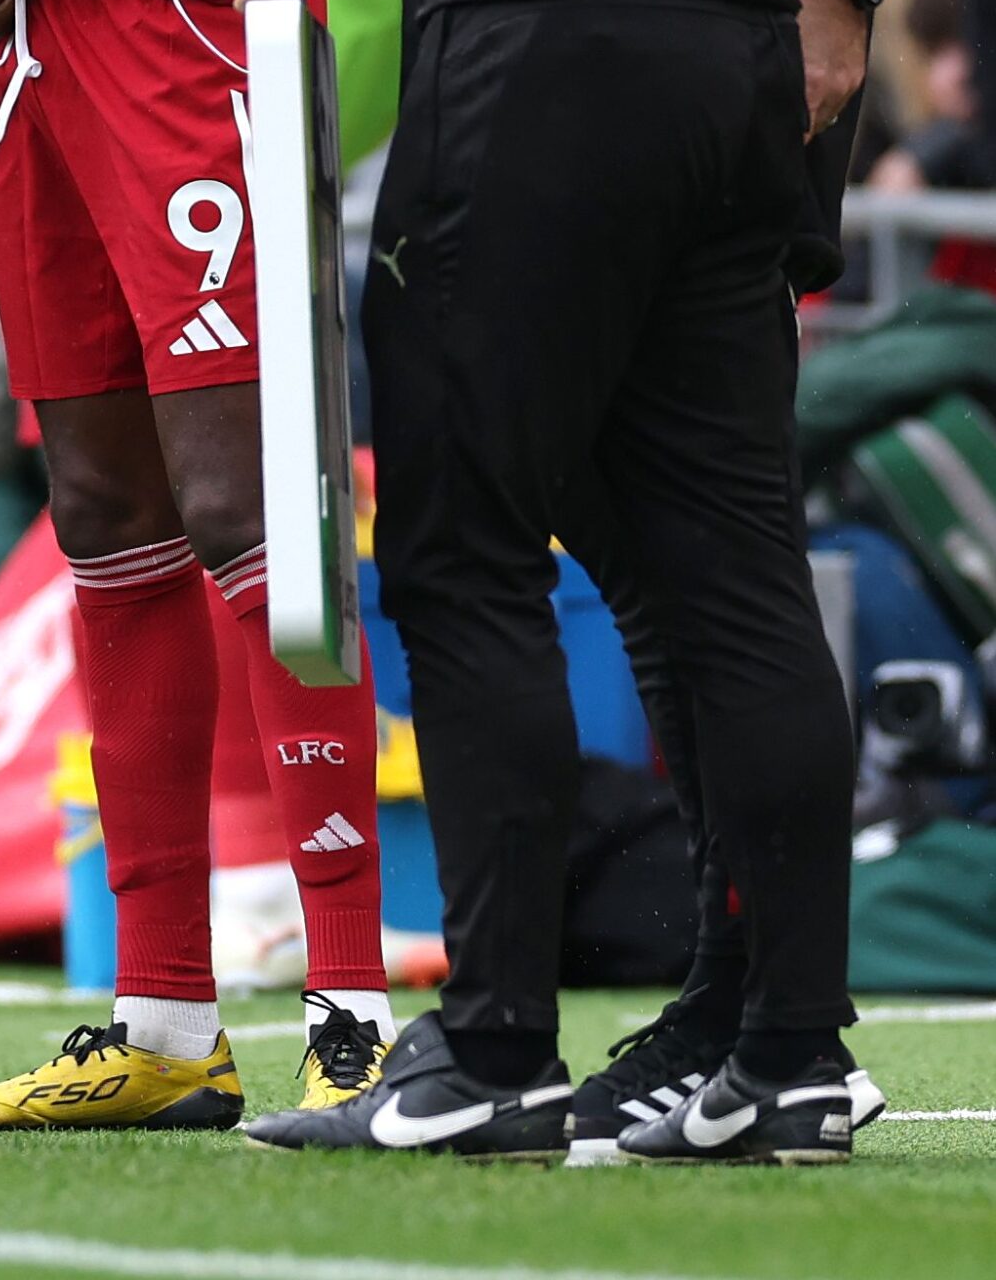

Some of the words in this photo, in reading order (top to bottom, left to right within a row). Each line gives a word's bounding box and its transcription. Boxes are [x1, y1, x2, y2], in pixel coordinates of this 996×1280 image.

[167, 179, 244, 292] 9
[277, 741, 345, 765] LFC
[17, 1073, 130, 1108] F50
